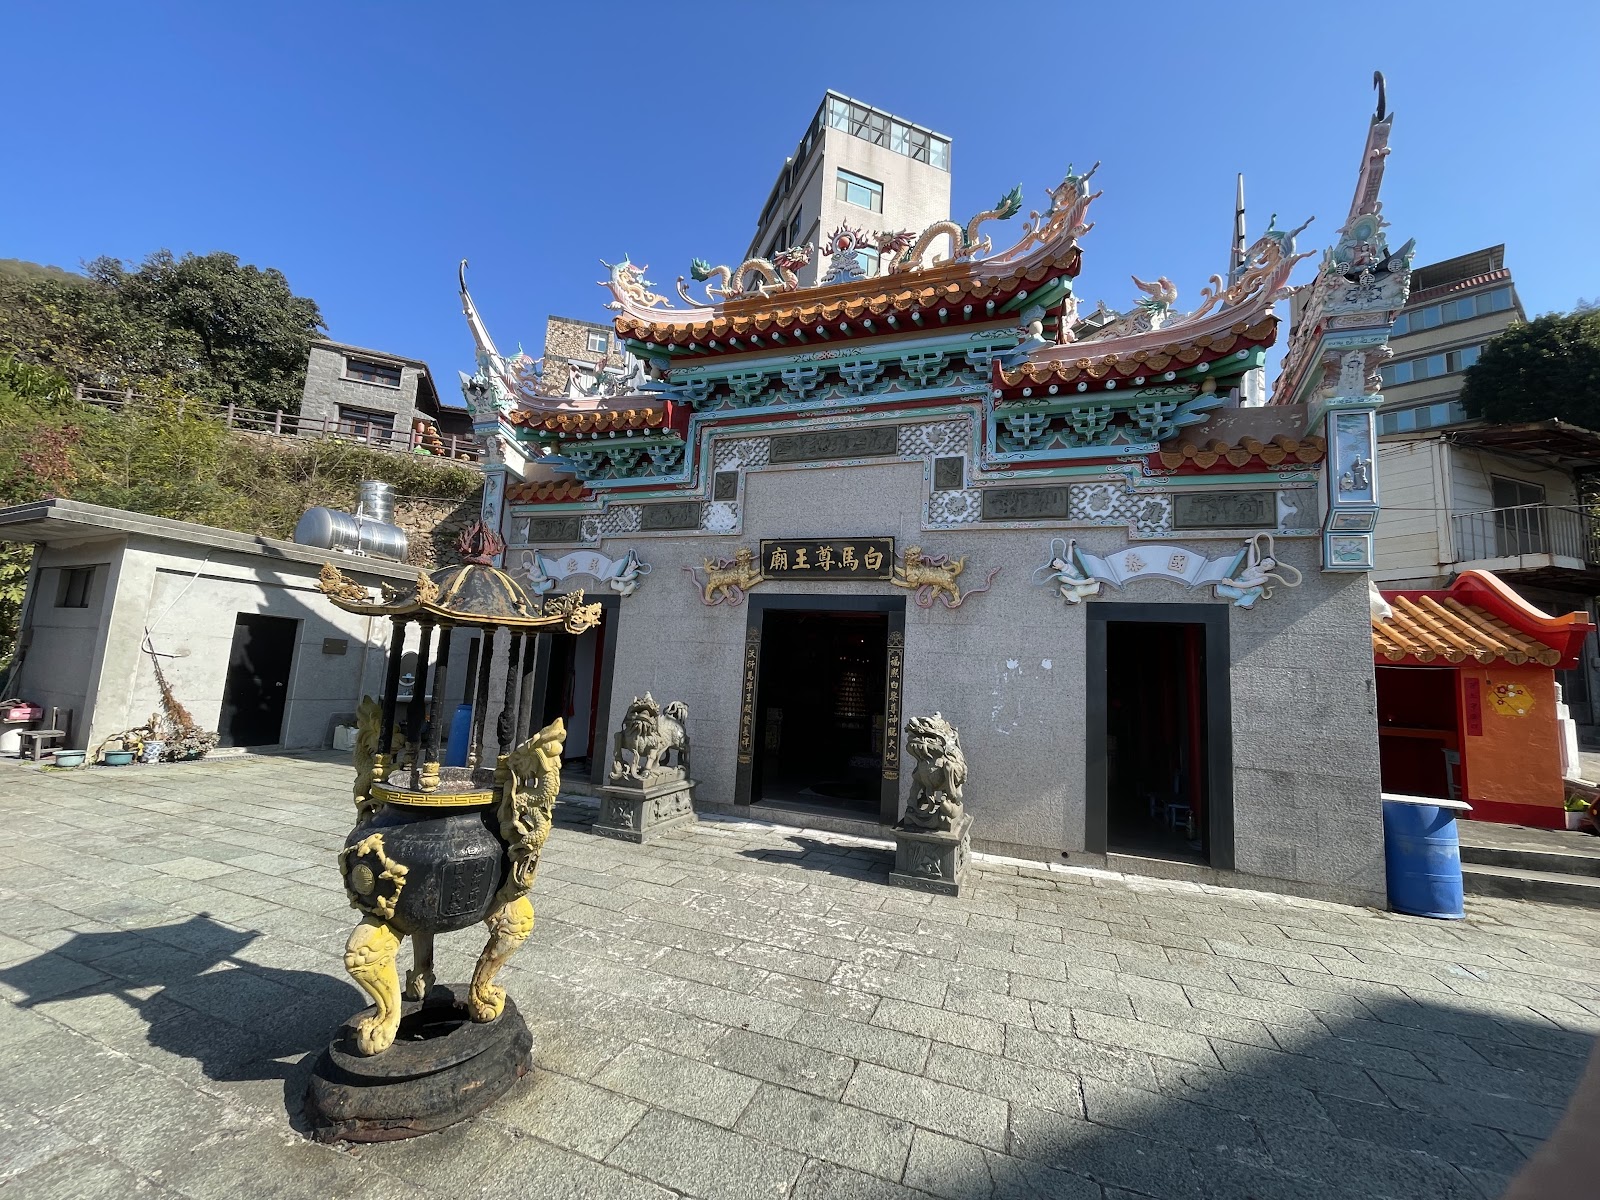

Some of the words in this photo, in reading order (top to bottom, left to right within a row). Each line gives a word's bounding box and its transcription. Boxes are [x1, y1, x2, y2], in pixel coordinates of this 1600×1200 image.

[769, 546, 884, 571] 白馬尊王廟
[1125, 552, 1189, 574] 國泰
